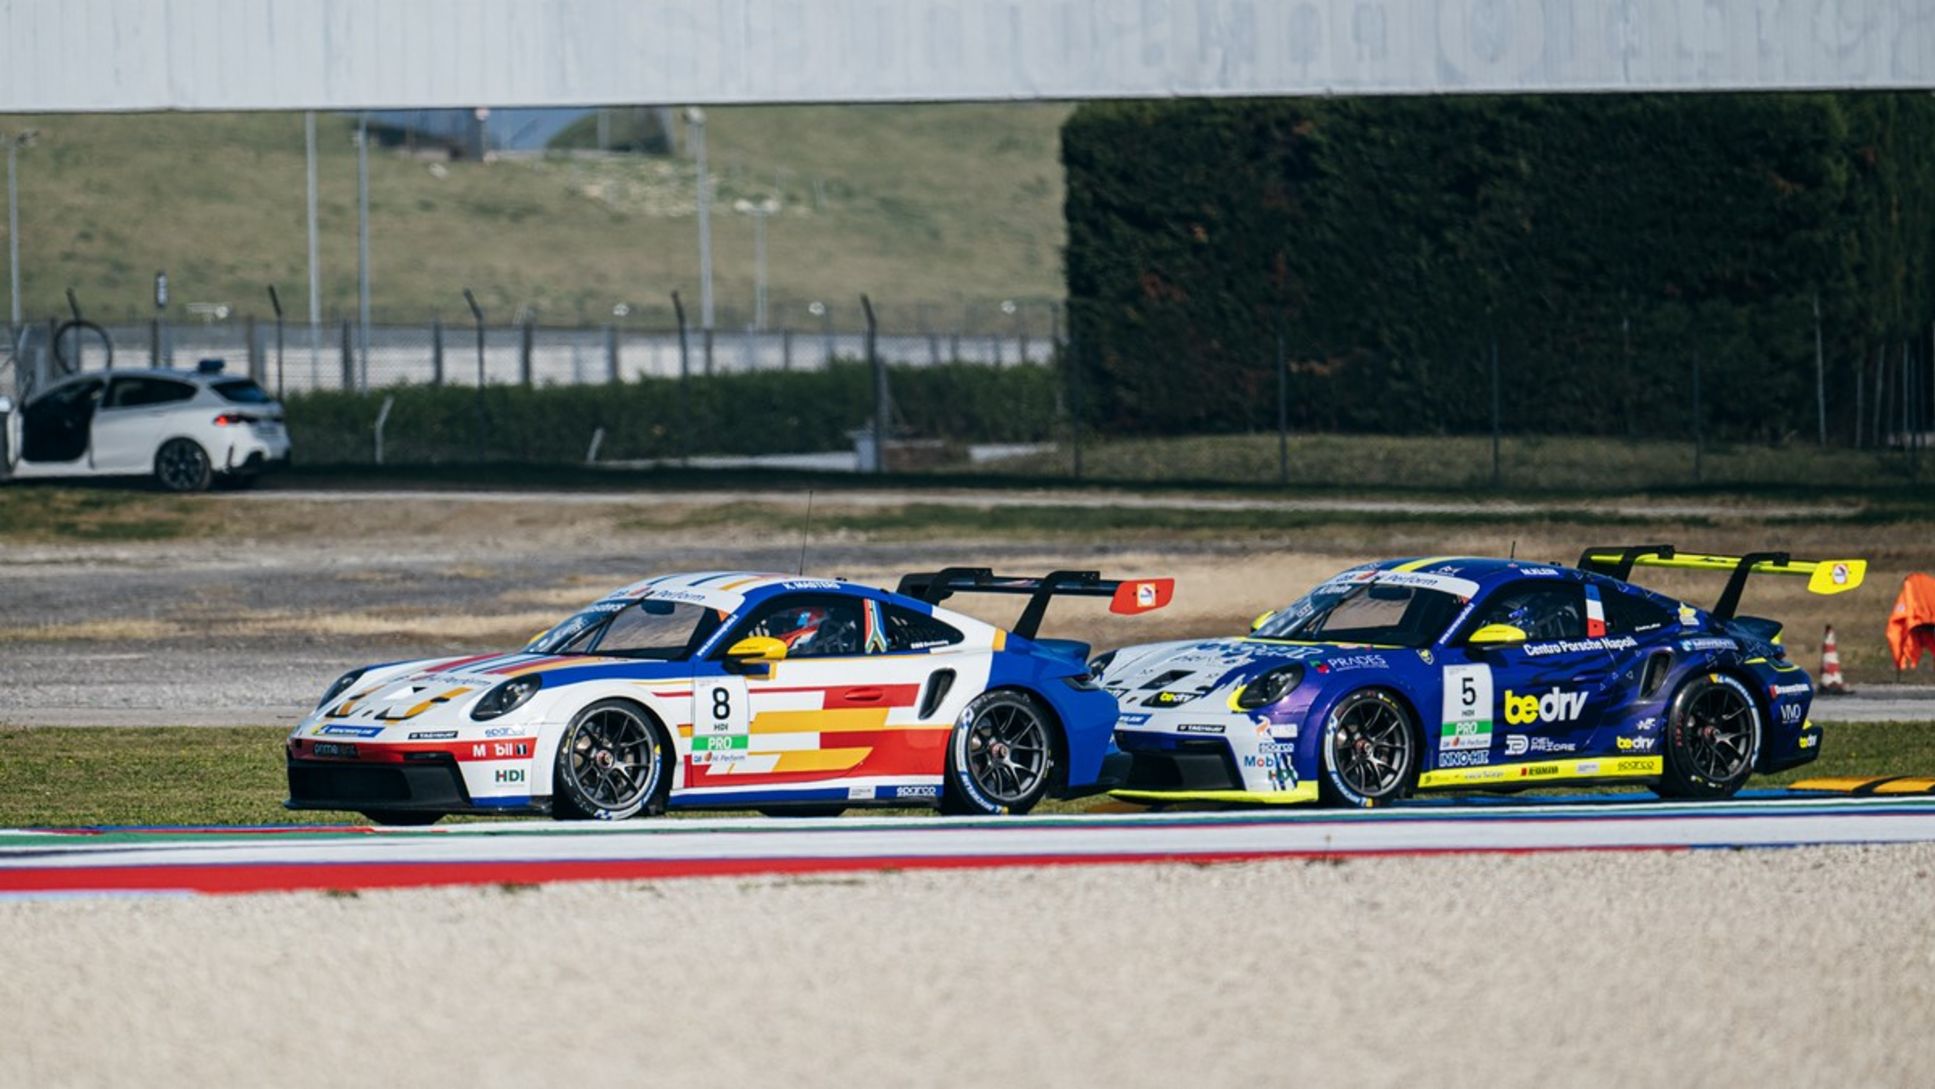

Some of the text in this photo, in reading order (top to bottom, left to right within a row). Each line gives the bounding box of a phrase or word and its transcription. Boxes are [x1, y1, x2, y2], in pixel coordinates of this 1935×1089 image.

[1523, 636, 1638, 656] Centro Porsche Napoli
[1327, 655, 1386, 668] PRADES
[1462, 677, 1476, 706] 5
[712, 686, 731, 720] 8
[1457, 721, 1478, 735] PRO
[708, 736, 732, 750] PRO
[496, 769, 525, 782] HDI
